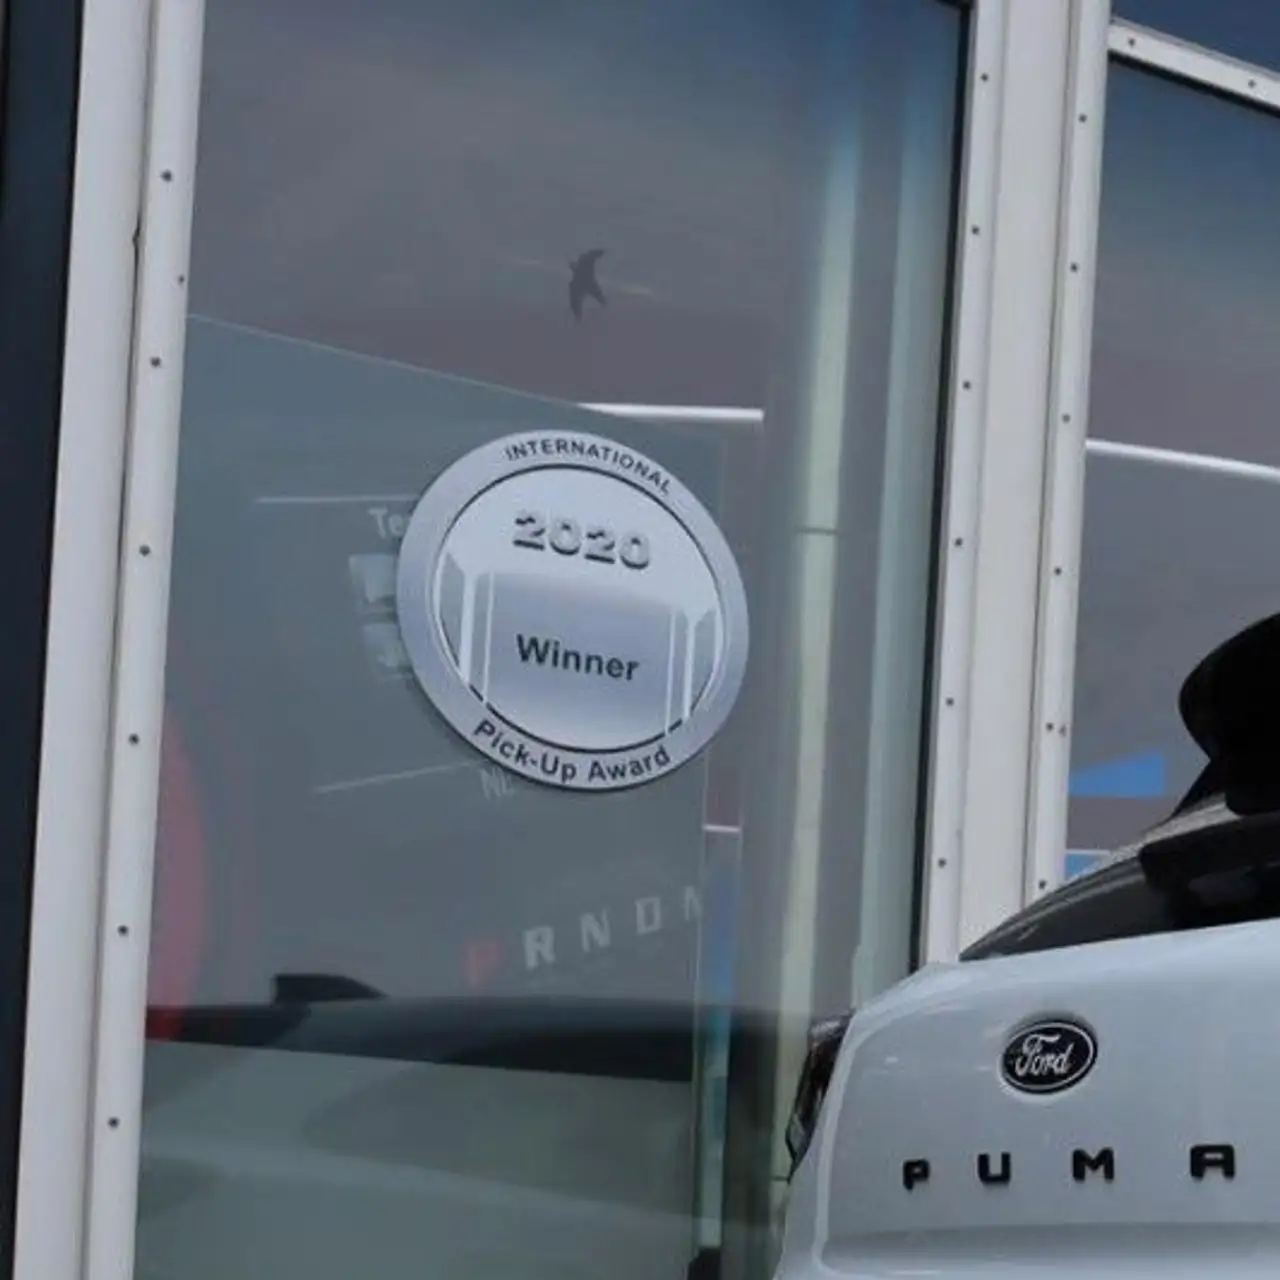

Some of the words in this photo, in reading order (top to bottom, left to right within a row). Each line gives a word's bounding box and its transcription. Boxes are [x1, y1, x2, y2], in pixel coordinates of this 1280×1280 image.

[505, 437, 674, 497] INTERNATIONAL
[513, 509, 651, 570] 2020
[517, 632, 641, 681] Winner
[474, 717, 578, 784] Pick-Up
[586, 746, 672, 782] Award
[1014, 1034, 1074, 1077] Ford
[901, 1142, 1236, 1190] PUMA
